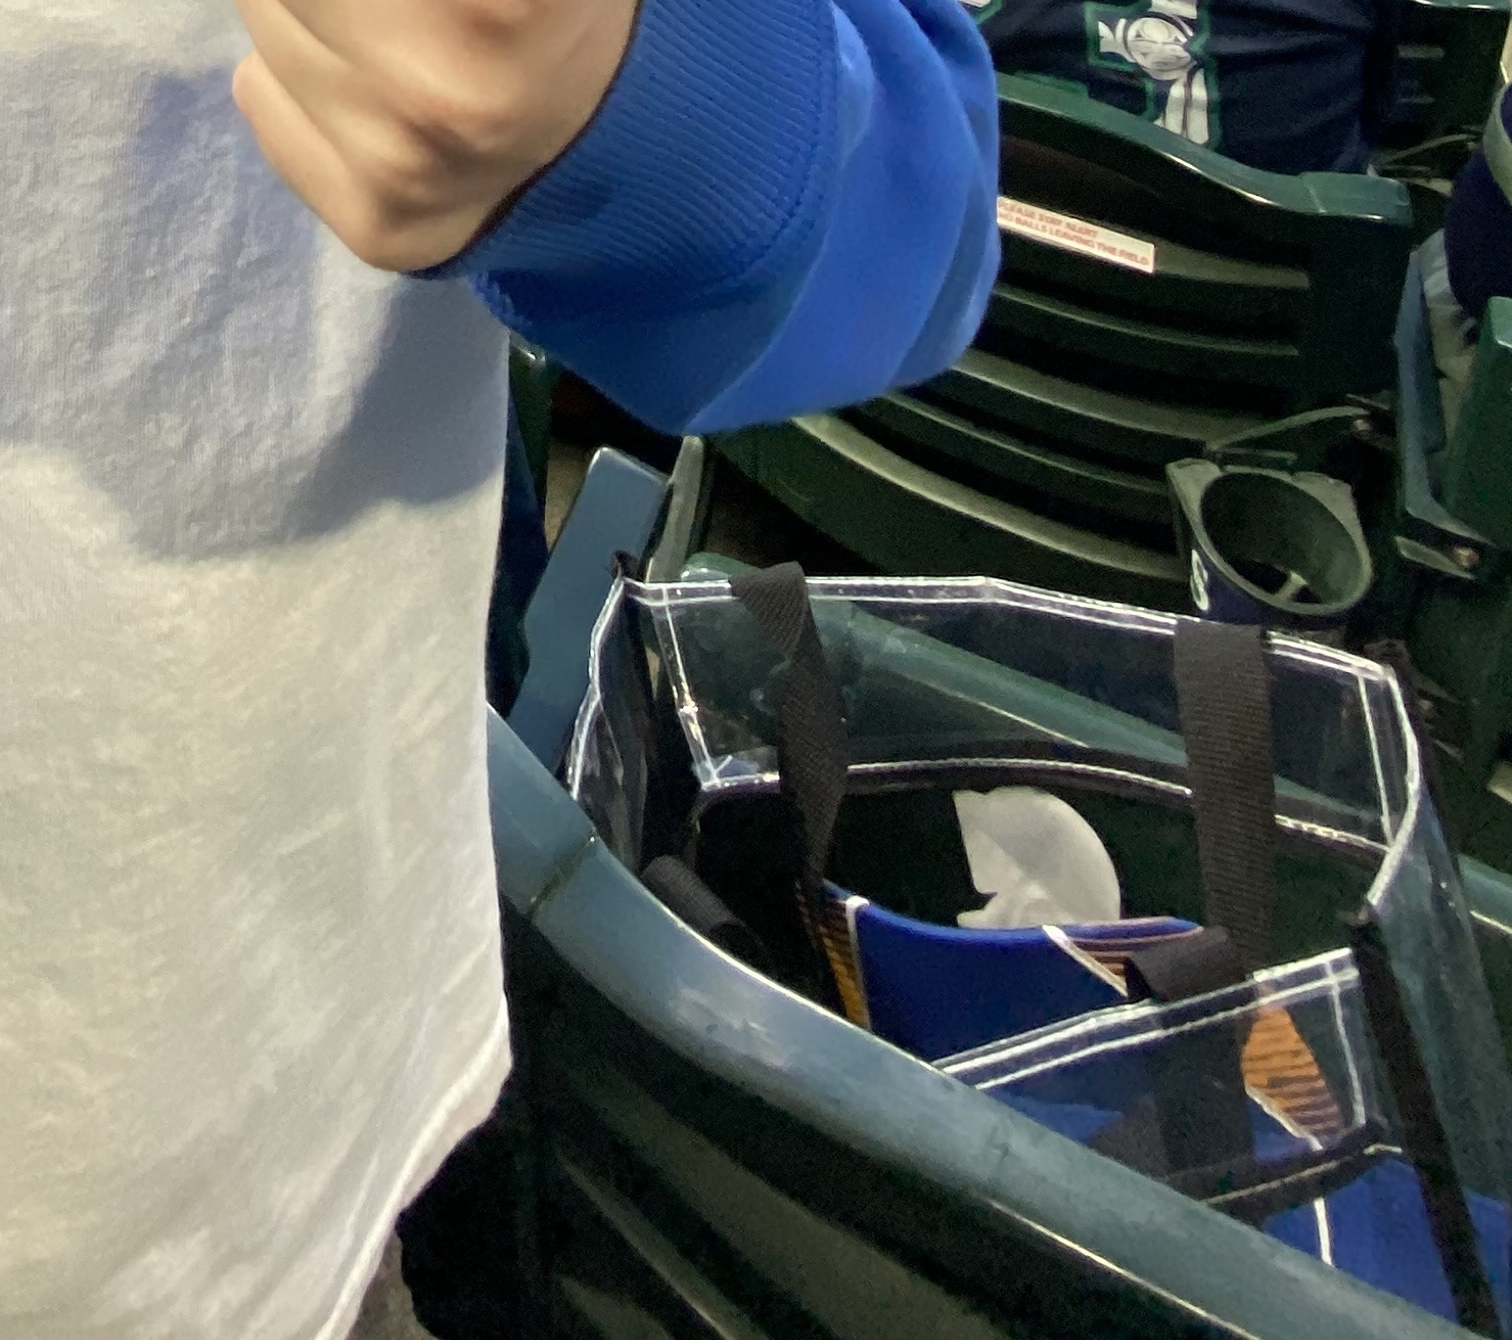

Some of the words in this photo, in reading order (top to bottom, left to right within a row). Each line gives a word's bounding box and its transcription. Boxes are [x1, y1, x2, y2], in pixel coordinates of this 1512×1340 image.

[1015, 216, 1048, 233] BALLS
[1097, 240, 1117, 255] THE
[1119, 248, 1150, 265] FIELD
